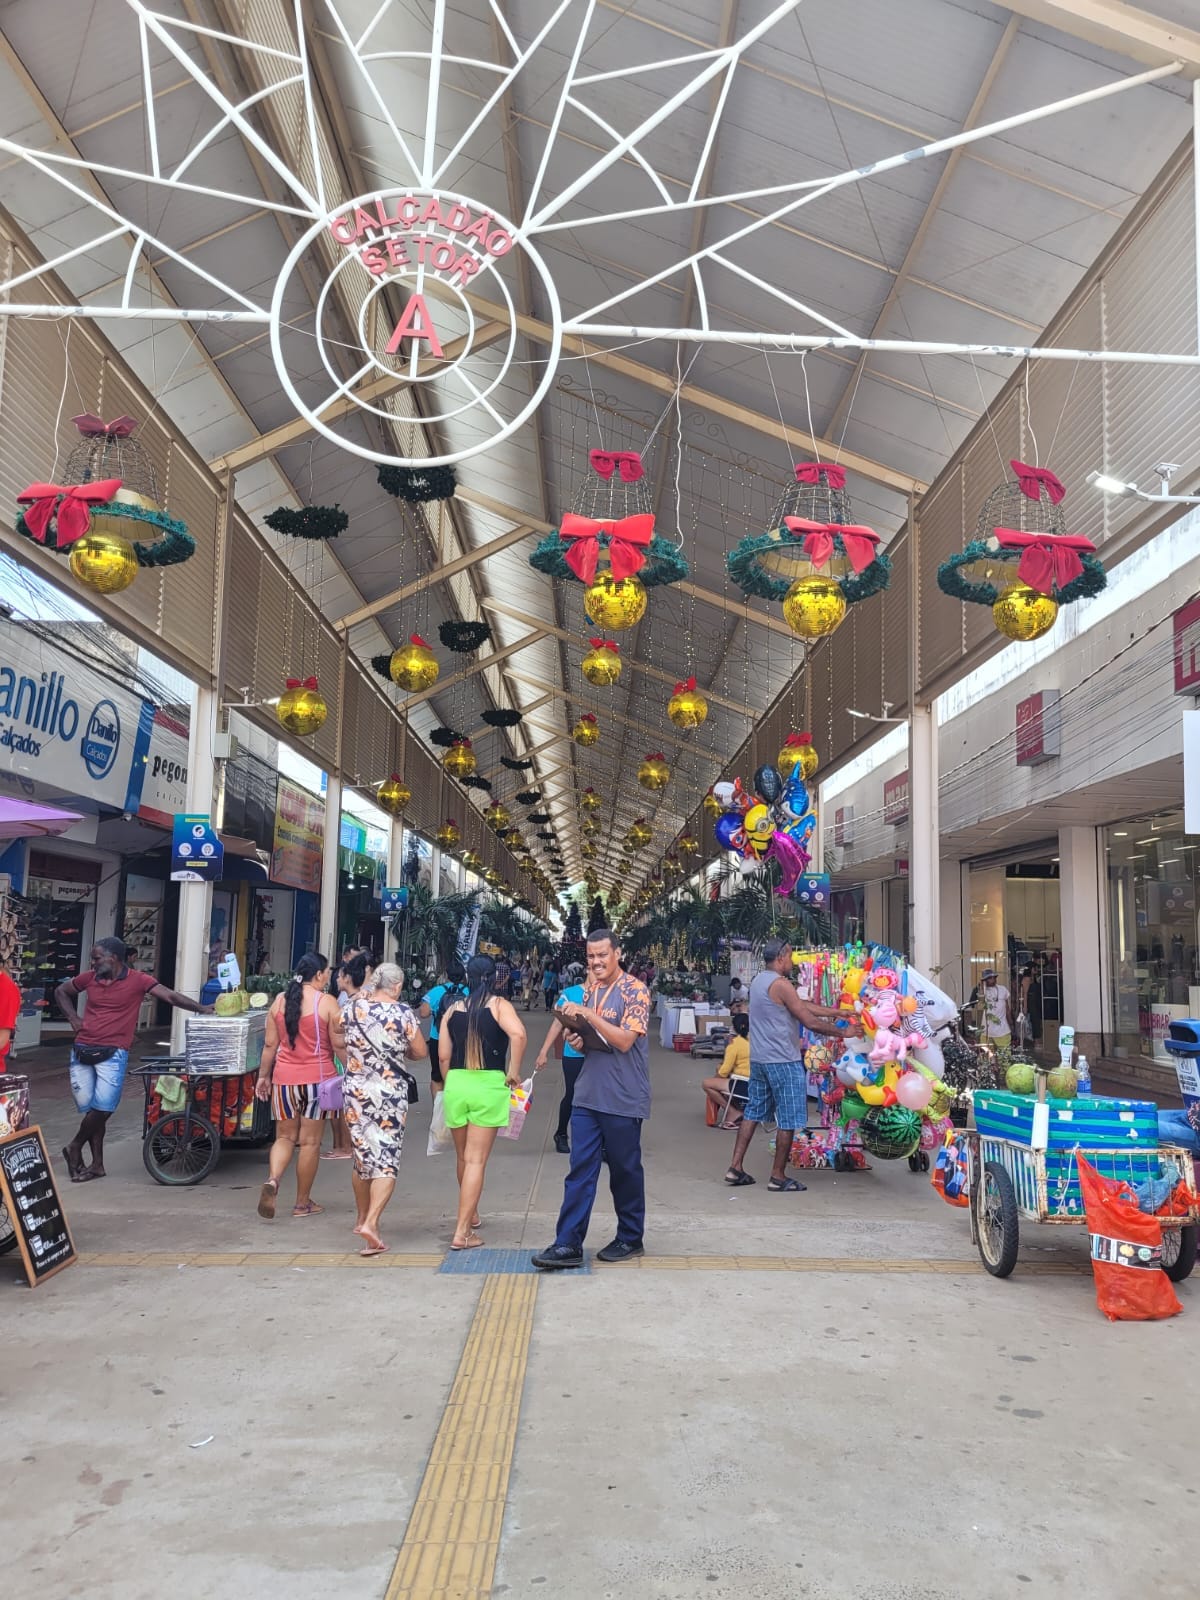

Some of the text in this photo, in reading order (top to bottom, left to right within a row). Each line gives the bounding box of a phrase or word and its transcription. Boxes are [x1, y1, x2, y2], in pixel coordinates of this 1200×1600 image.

[330, 196, 513, 257] CALÇADÃO
[361, 236, 479, 286] SETOR
[384, 293, 444, 359] A
[0, 666, 79, 742] anillo
